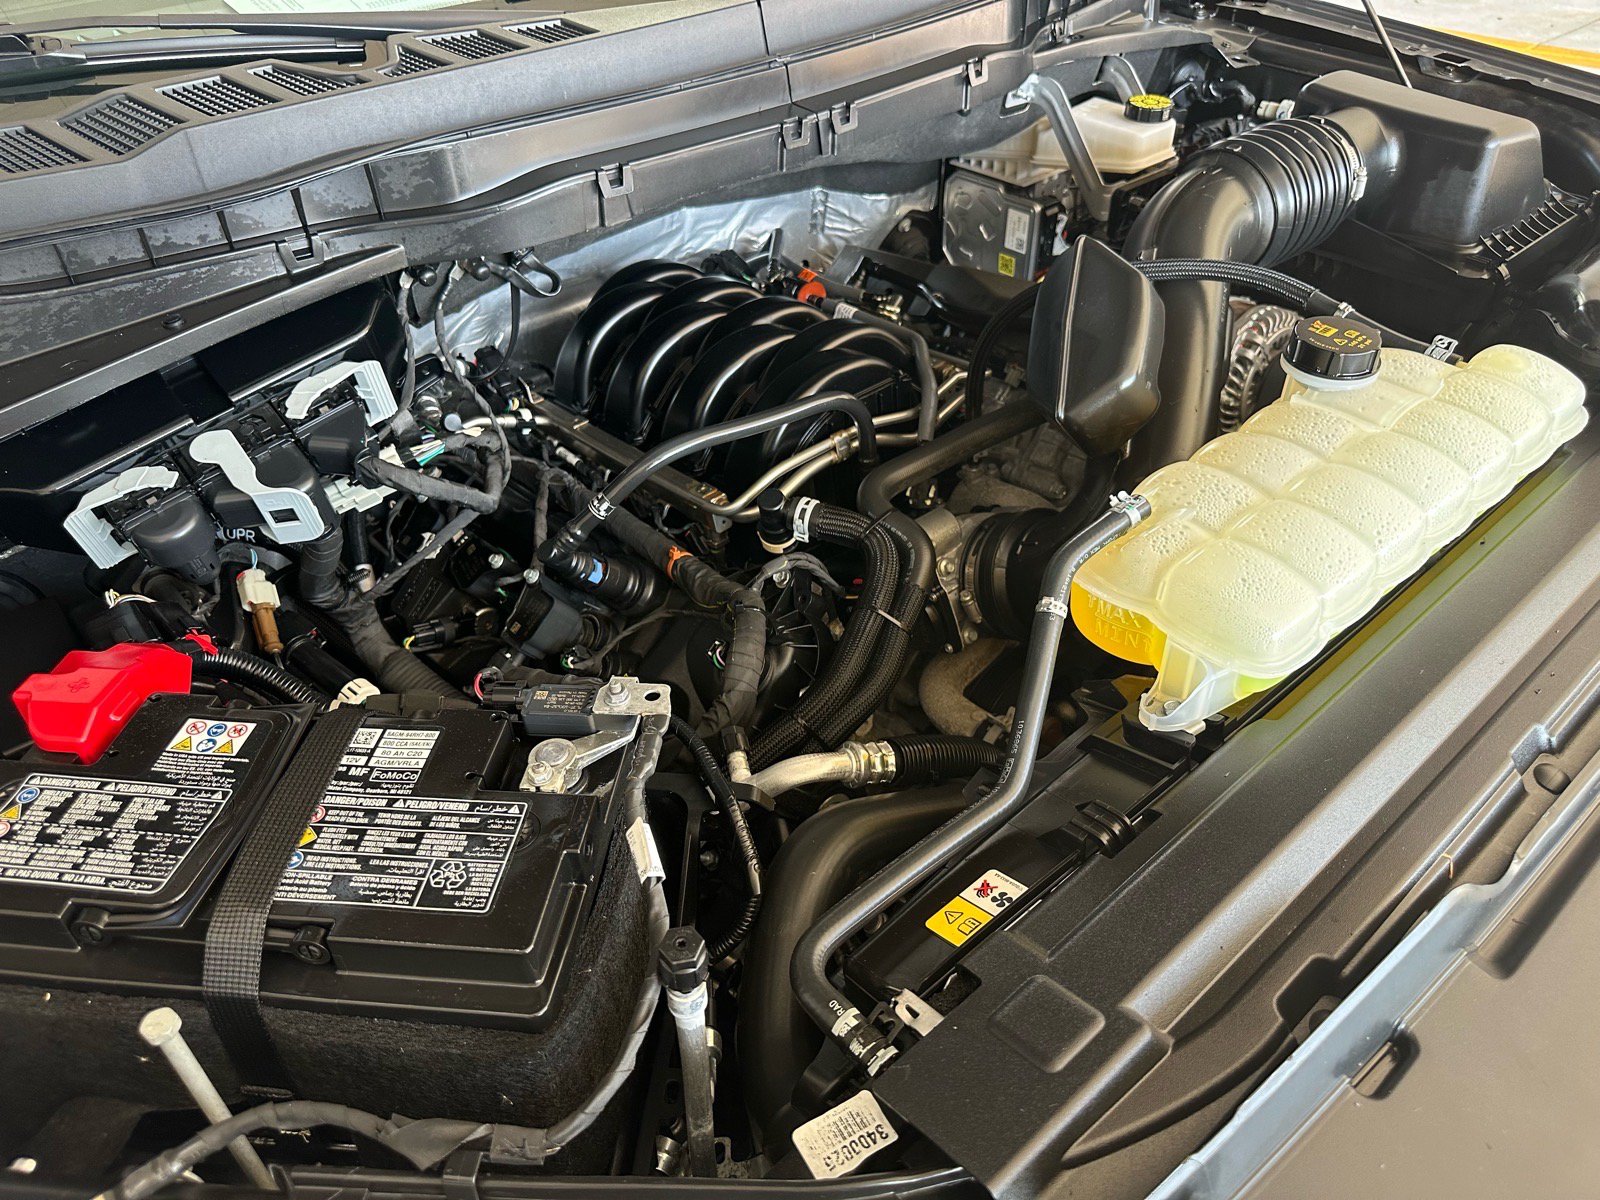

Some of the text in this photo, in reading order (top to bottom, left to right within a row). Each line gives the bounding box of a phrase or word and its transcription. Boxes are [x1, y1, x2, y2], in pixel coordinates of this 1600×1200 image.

[226, 528, 256, 543] UPR
[1095, 597, 1141, 628] MAX
[1096, 618, 1140, 648] MIN
[348, 767, 370, 775] MF
[373, 771, 418, 779] FoMoCo
[40, 778, 101, 789] DANGER/POISON
[115, 784, 177, 796] PELIGRO/VENENO
[323, 795, 388, 806] DANGER/POISON
[405, 800, 469, 810] PELIGRO/VENENO
[16, 869, 32, 877] PAS
[30, 870, 60, 880] OUVRIR.
[62, 874, 106, 885] NO LA ABRA.
[829, 1000, 846, 1016] RAD
